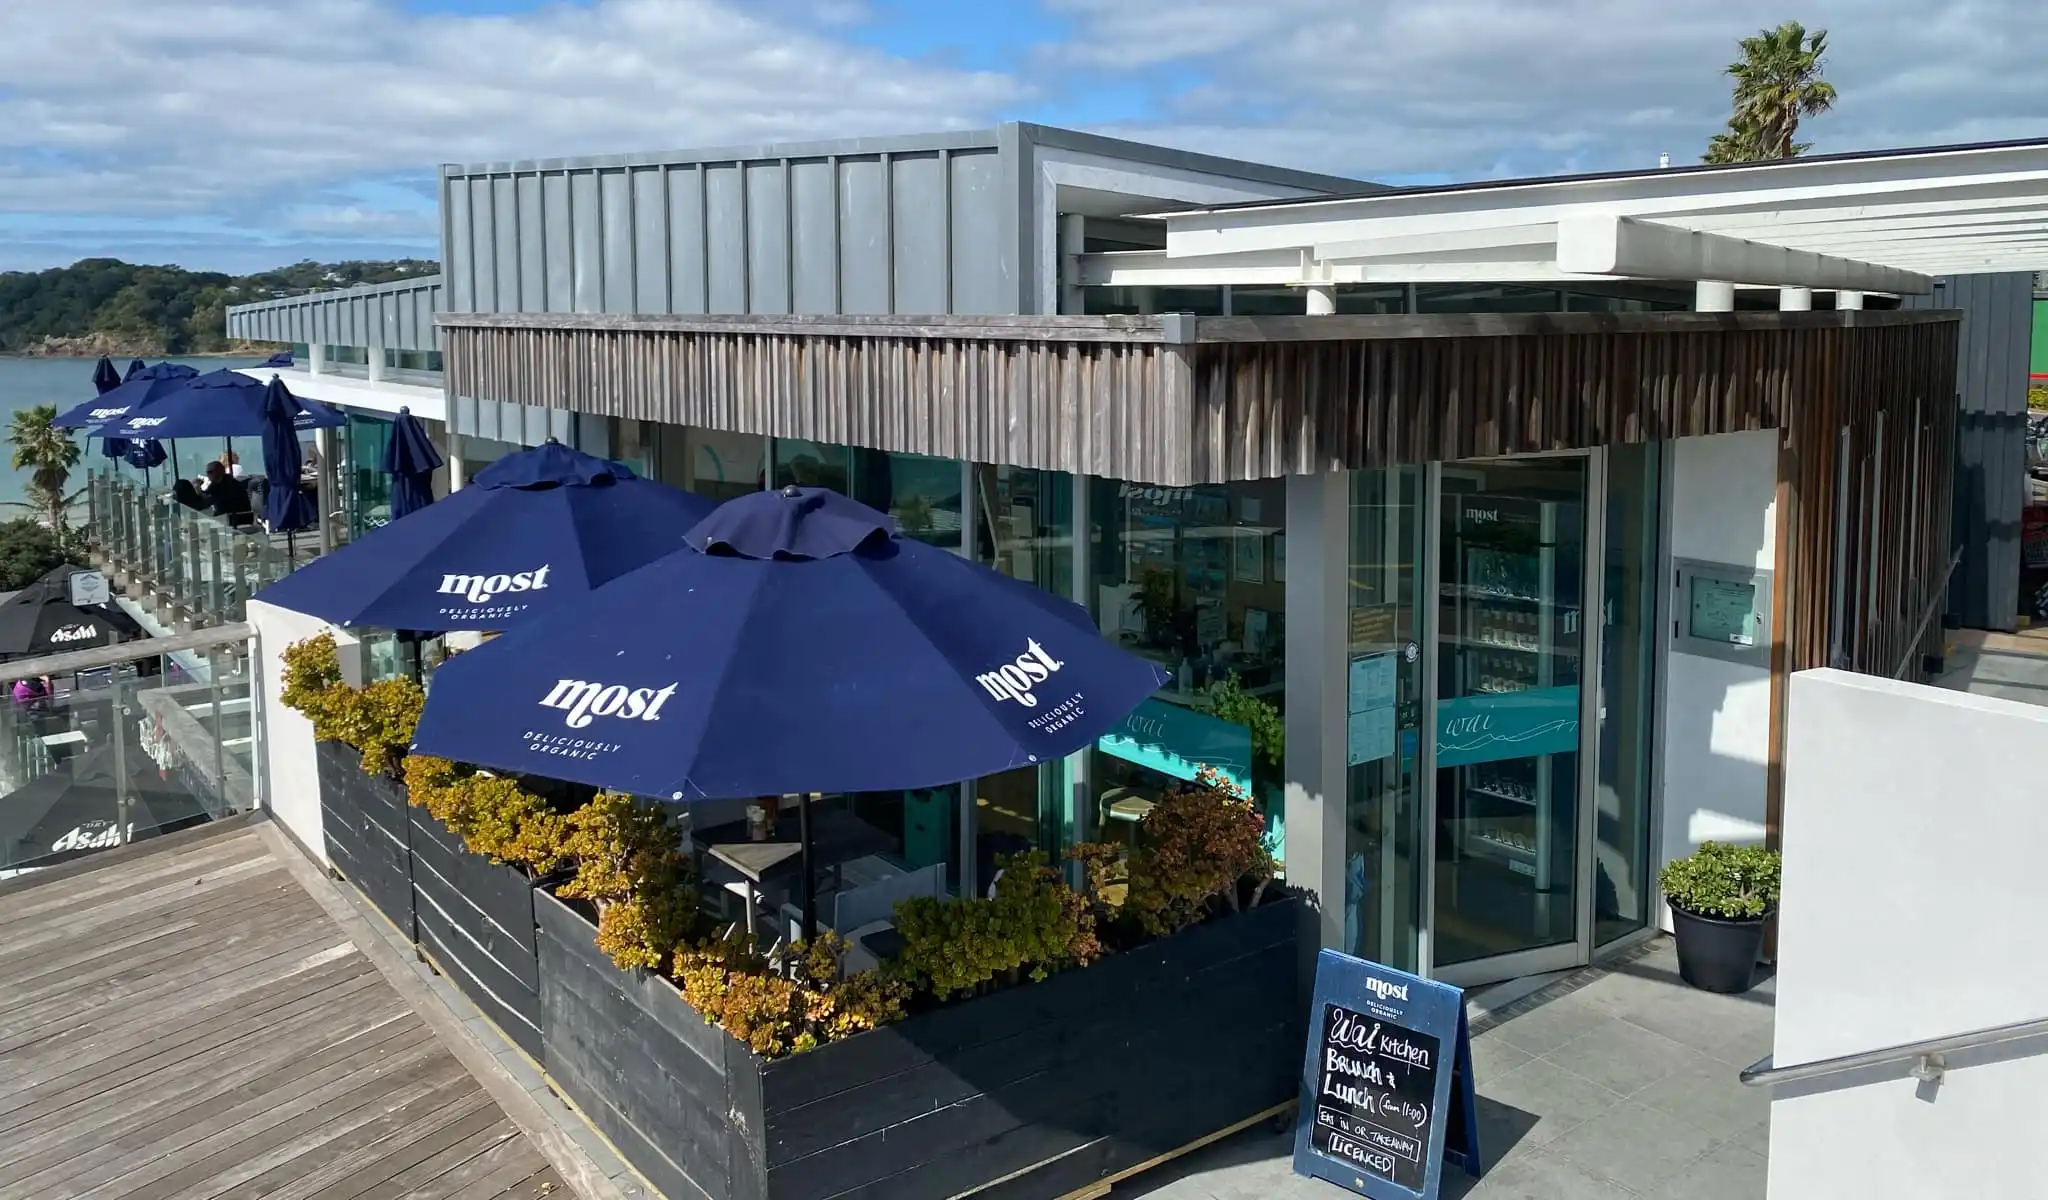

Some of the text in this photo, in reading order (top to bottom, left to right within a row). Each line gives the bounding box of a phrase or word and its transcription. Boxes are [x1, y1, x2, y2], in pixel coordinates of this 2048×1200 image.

[1465, 508, 1499, 525] most
[436, 563, 550, 603] most
[439, 604, 528, 614] DELICIOUSLY
[450, 612, 511, 620] ORGANIC
[975, 636, 1064, 707] most
[538, 679, 679, 728] most
[1028, 692, 1084, 728] DELICIOUSLY
[1045, 707, 1085, 733] ORGANIC
[1126, 713, 1168, 738] wai
[1446, 704, 1496, 736] wai
[523, 731, 622, 752] DELICIOUSLY
[530, 743, 598, 760] ORGANIC
[51, 822, 134, 852] Asahi
[1365, 976, 1408, 1001] most
[1366, 1000, 1403, 1016] DELICIOUSLY
[1371, 1007, 1397, 1019] ORGANIC
[1330, 1008, 1429, 1066] Wai Kitchen
[1320, 1111, 1334, 1126] EAT
[1354, 1126, 1369, 1139] OR
